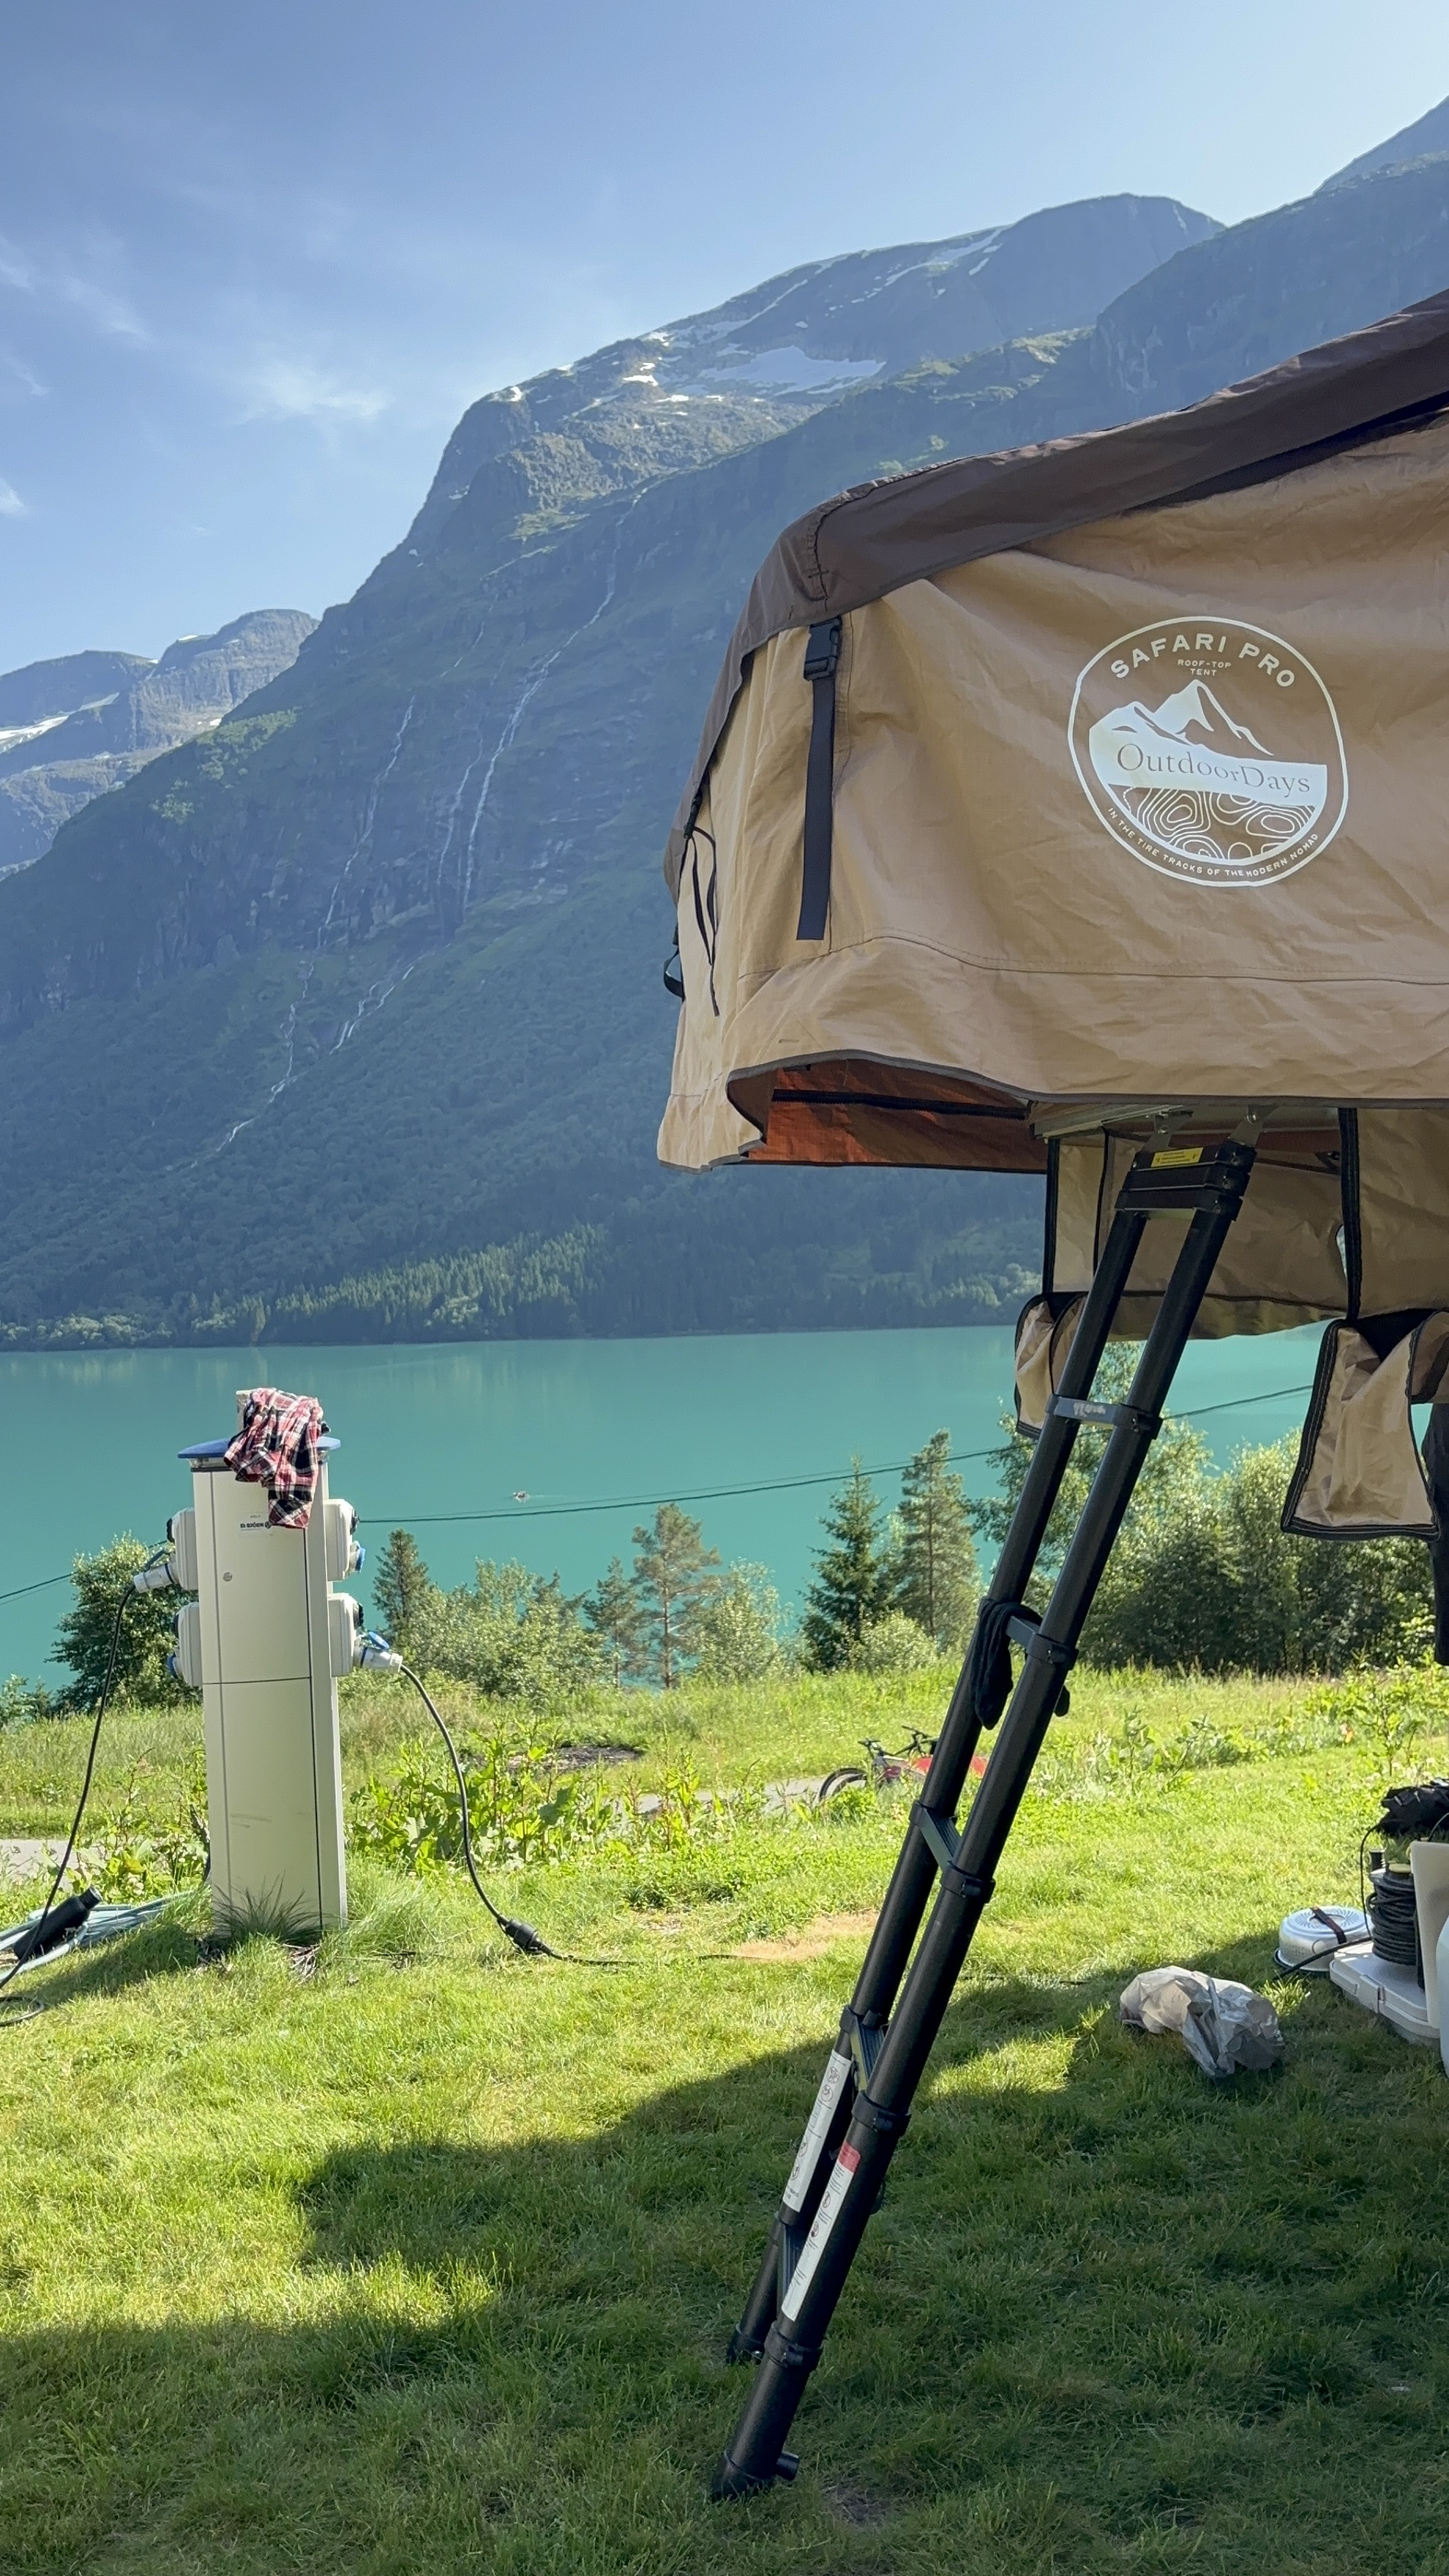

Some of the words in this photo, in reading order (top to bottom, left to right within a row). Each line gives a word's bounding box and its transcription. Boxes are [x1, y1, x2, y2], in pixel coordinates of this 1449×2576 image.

[1111, 633, 1227, 678] SAFARI
[1238, 643, 1295, 687] PRO
[1177, 659, 1232, 668] ROOF-TOP
[1190, 668, 1218, 677] TENT
[1117, 743, 1311, 798] OutdoorDays
[1108, 807, 1118, 819] IN
[1118, 820, 1135, 839] THE
[1137, 838, 1159, 856] TIRE
[1163, 854, 1202, 874] TRACKS
[1224, 869, 1244, 877] THE
[1246, 858, 1288, 877] MODERN
[1289, 834, 1319, 861] NOMAD
